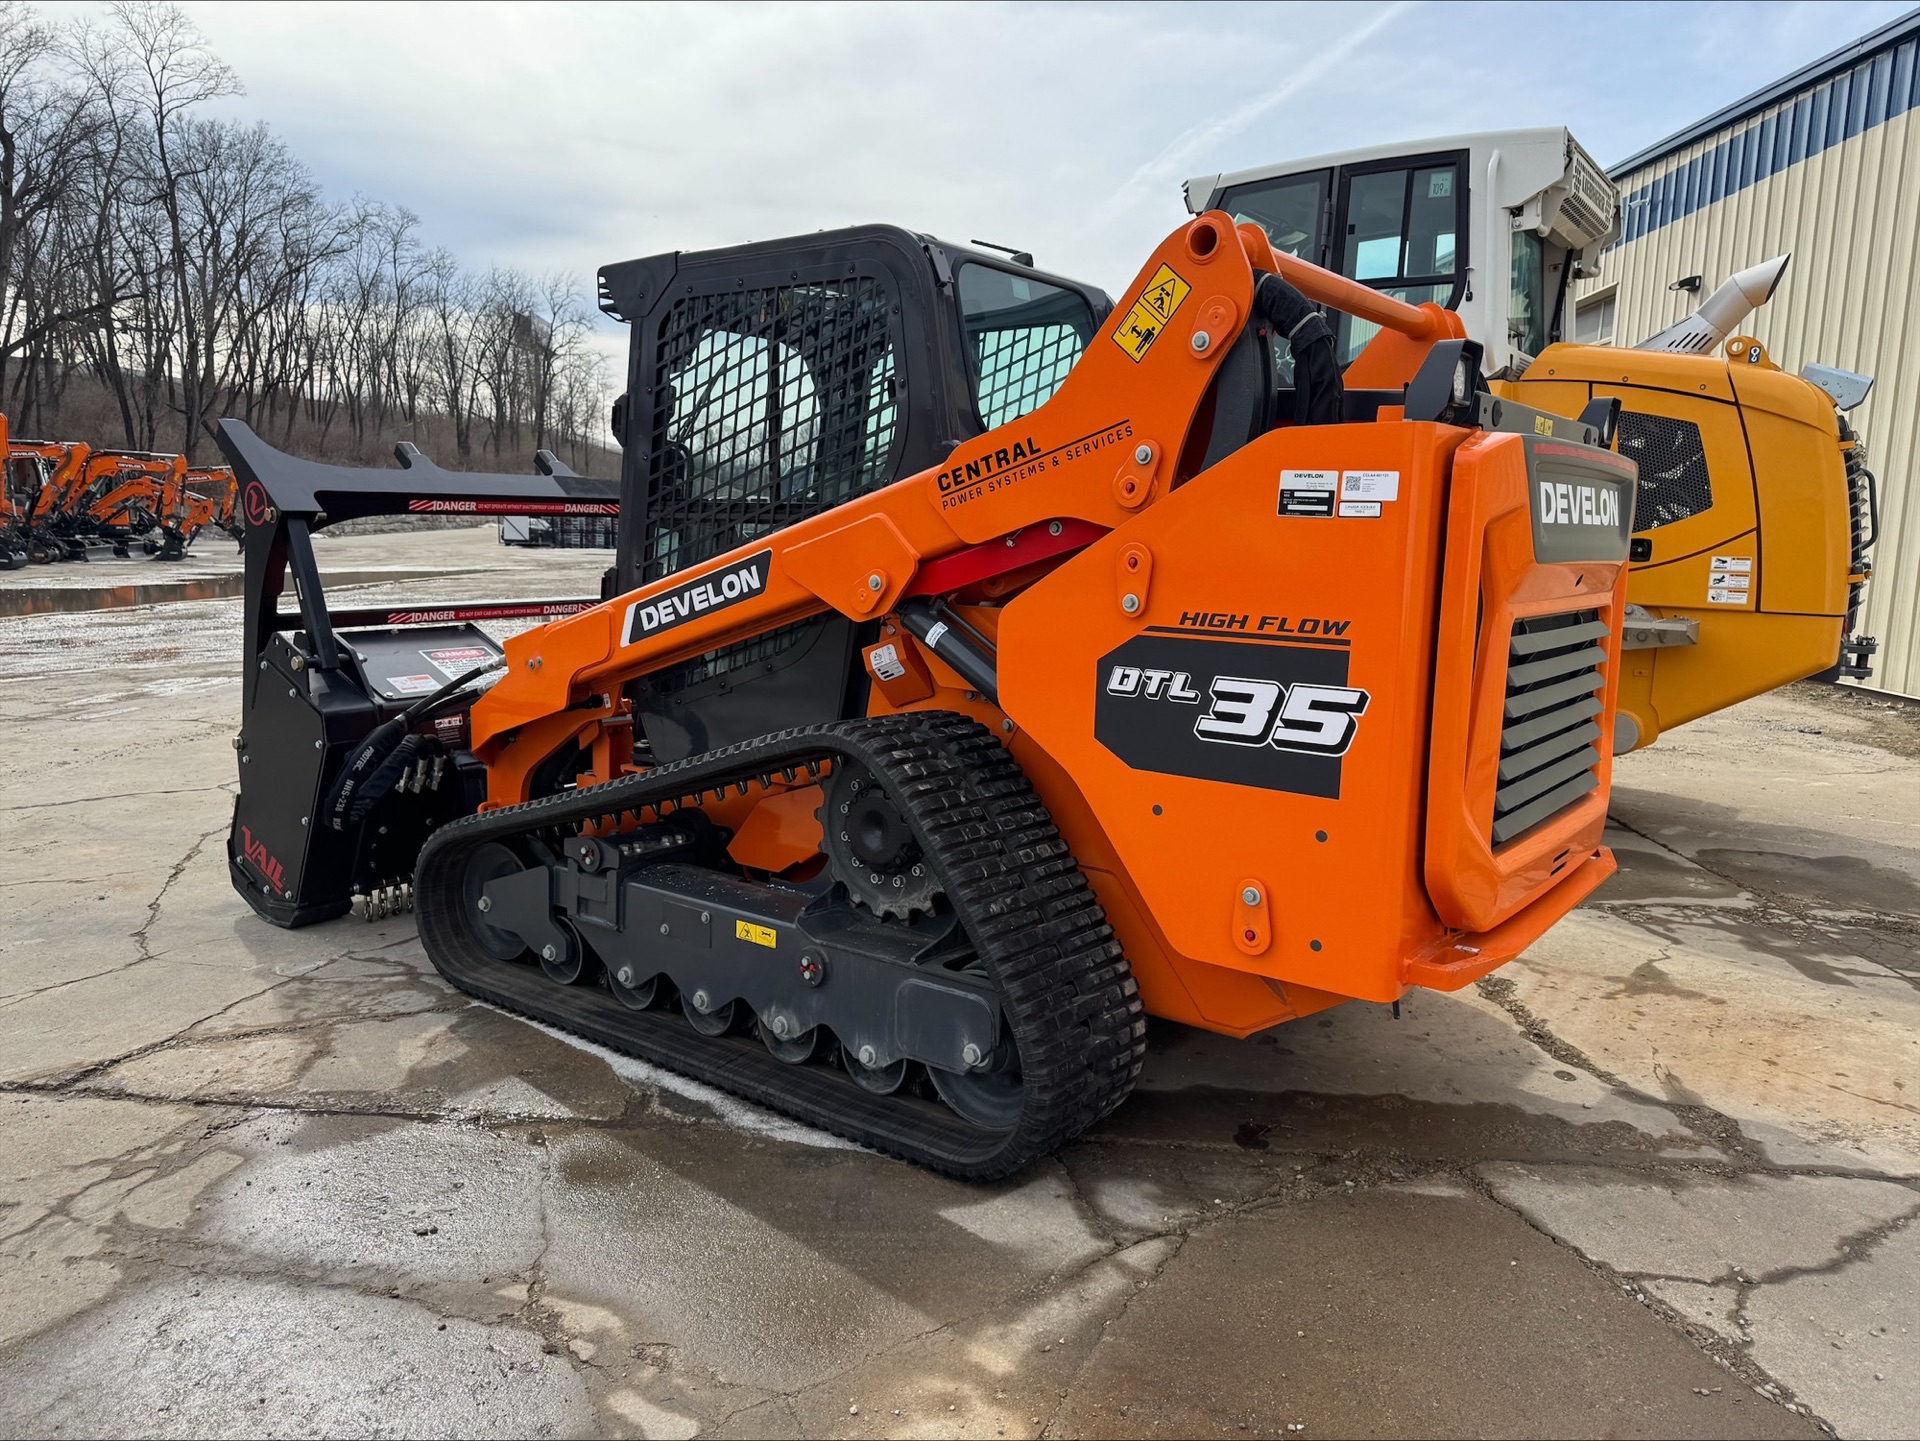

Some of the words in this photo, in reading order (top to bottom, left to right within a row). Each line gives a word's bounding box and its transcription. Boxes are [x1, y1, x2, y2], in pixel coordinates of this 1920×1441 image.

[1432, 182, 1444, 195] 109
[937, 436, 1042, 493] CENTRAL
[942, 488, 983, 511] POWER
[988, 461, 1045, 492] SYSTEMS
[1052, 456, 1060, 467] &
[1066, 426, 1134, 461] SERVICES
[436, 501, 477, 511] DANGER
[564, 503, 600, 514] DANGER
[1540, 481, 1619, 526] DEVELON
[415, 611, 456, 622] DANGER
[543, 604, 578, 614] DANGER
[639, 565, 761, 631] DEVELON
[1179, 611, 1249, 630] HIGH
[1257, 616, 1351, 636] FLOW
[438, 649, 479, 658] DANGER
[1107, 665, 1211, 705] DTL
[1193, 675, 1372, 757] 35
[352, 745, 375, 771] PROTEC
[241, 825, 284, 890] VAIL
